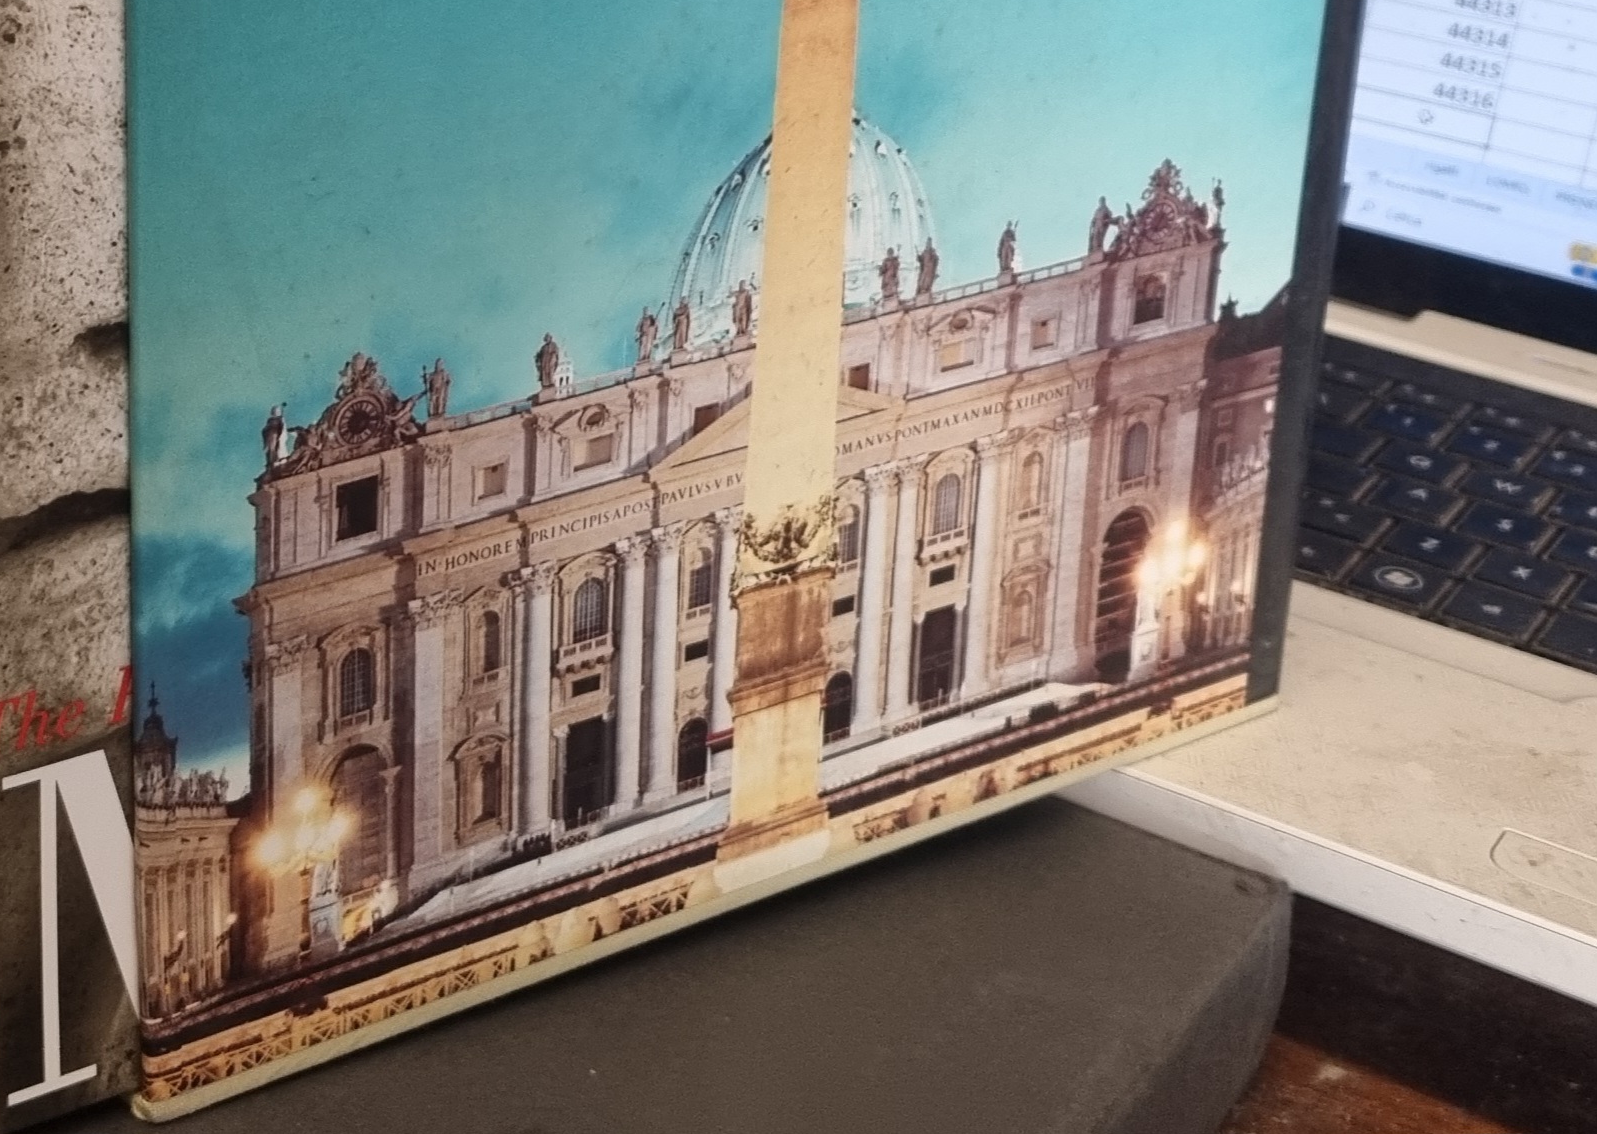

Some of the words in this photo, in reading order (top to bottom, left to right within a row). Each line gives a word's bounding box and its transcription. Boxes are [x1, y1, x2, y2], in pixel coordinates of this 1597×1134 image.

[1447, 21, 1509, 49] 44314
[1440, 51, 1501, 79] 44315
[1432, 81, 1494, 110] 44316
[417, 558, 438, 577] IN
[445, 537, 528, 570] HONOREM
